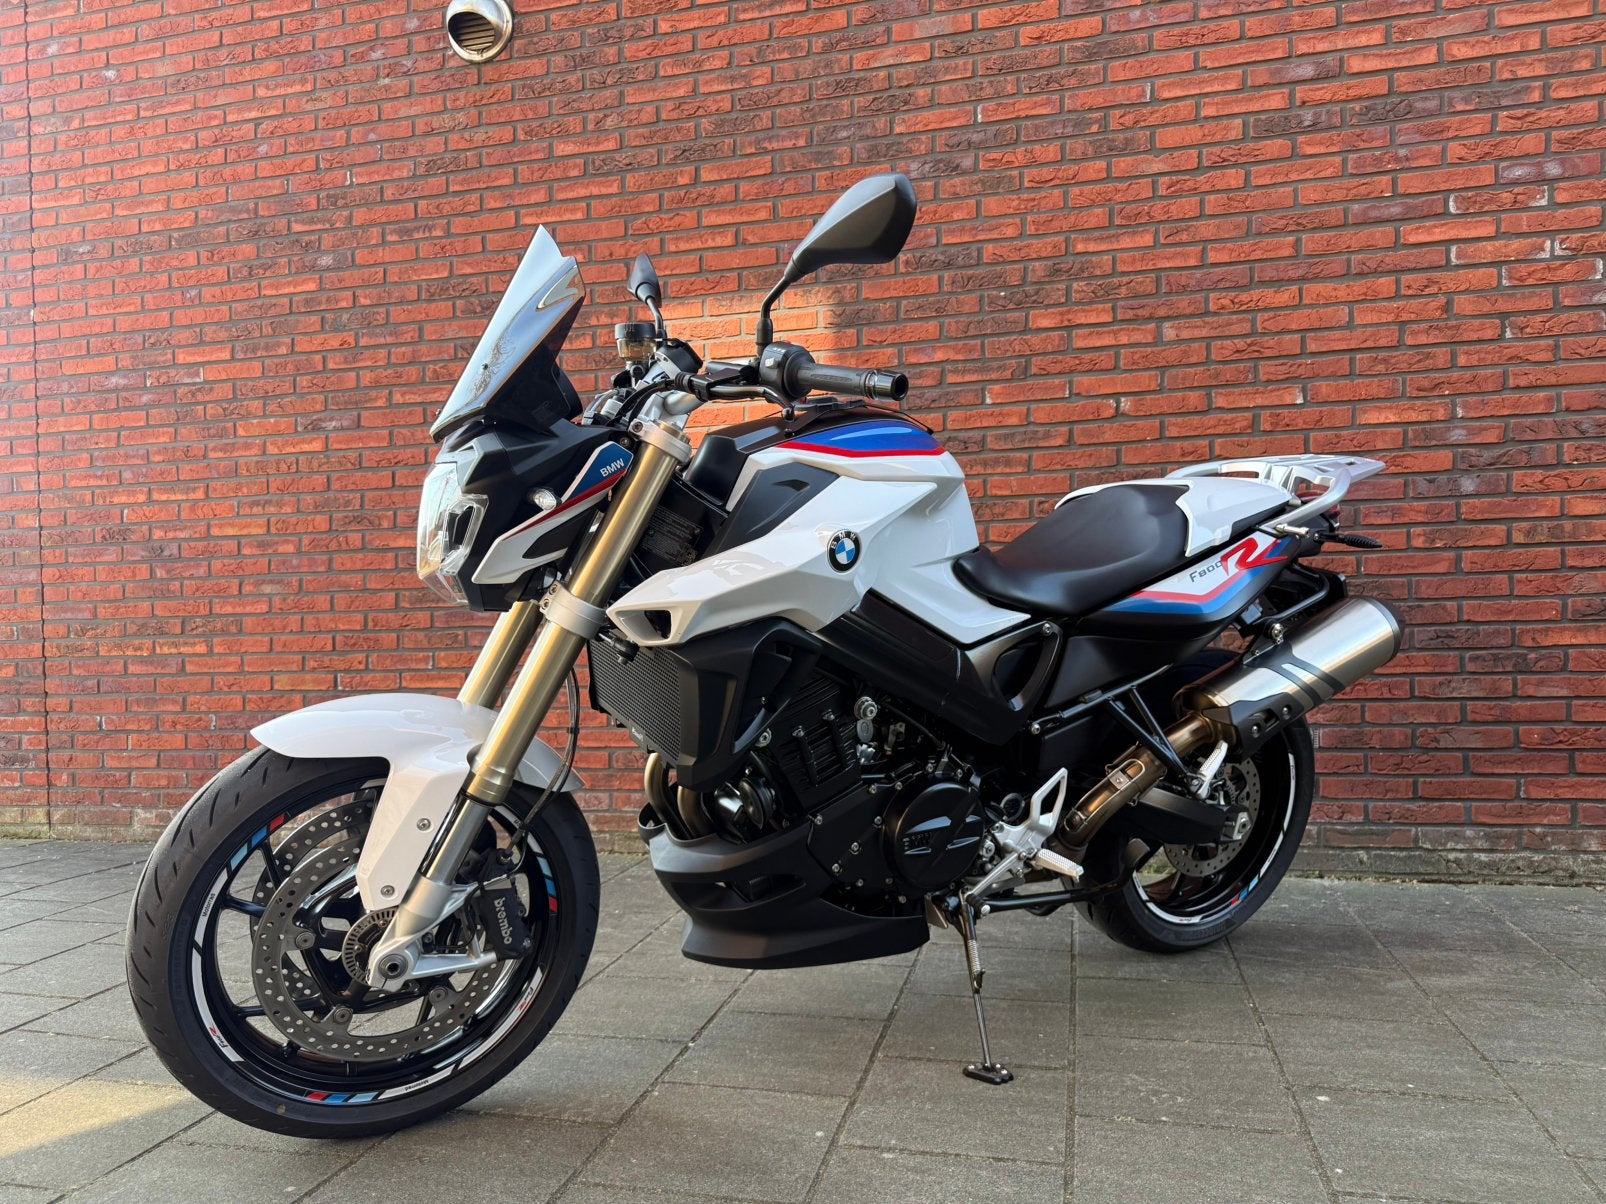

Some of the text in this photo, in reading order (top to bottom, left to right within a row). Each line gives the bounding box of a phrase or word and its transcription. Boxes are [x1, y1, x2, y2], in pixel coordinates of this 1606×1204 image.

[600, 458, 624, 477] BMW
[830, 531, 856, 549] BMW
[494, 897, 513, 945] brembo
